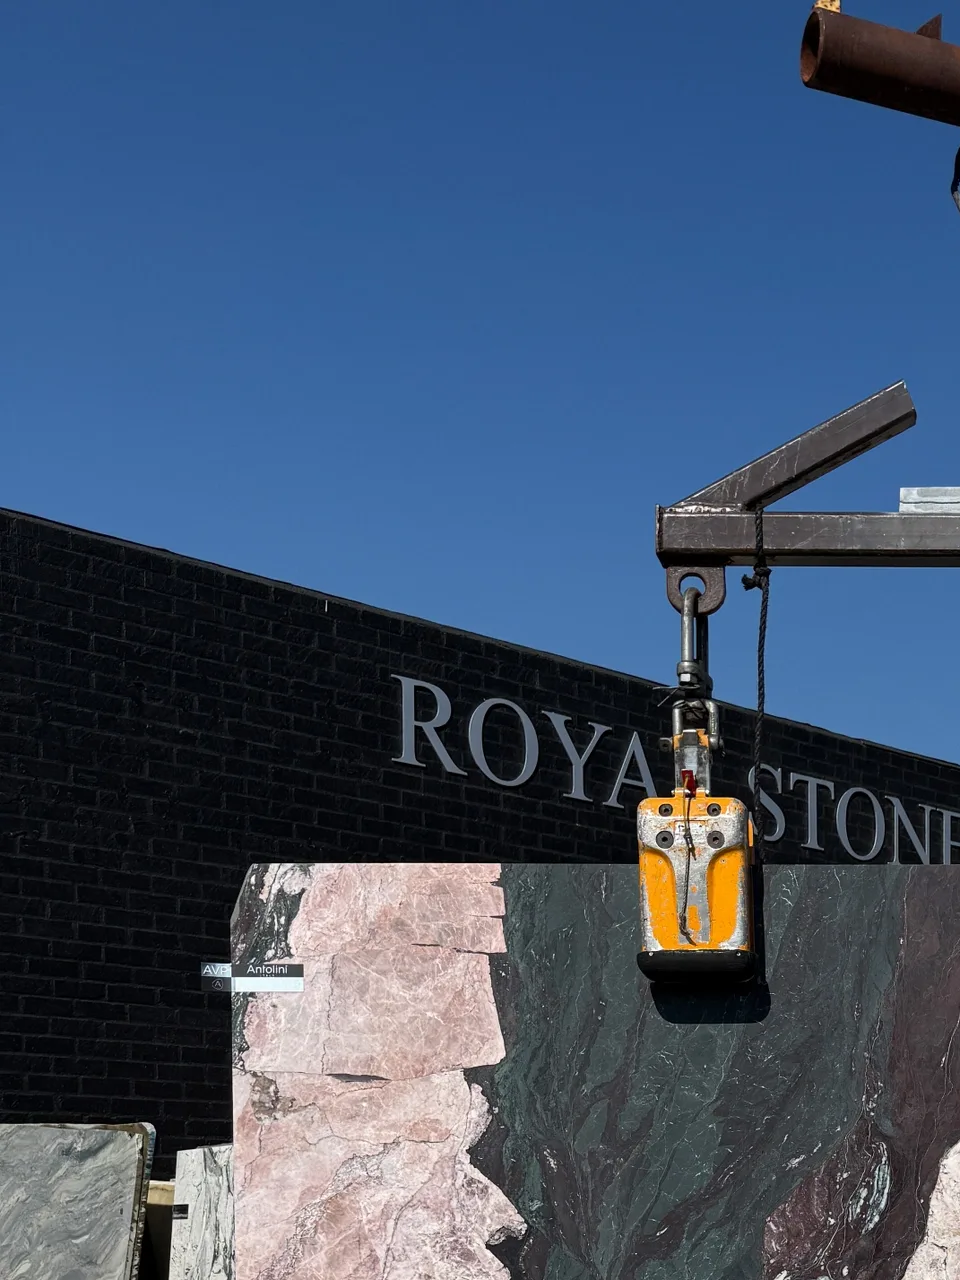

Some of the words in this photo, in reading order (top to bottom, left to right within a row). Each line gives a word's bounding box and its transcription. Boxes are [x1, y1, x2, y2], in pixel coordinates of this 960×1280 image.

[391, 673, 658, 809] ROYA
[203, 964, 228, 975] AVP
[246, 964, 288, 974] Antolini
